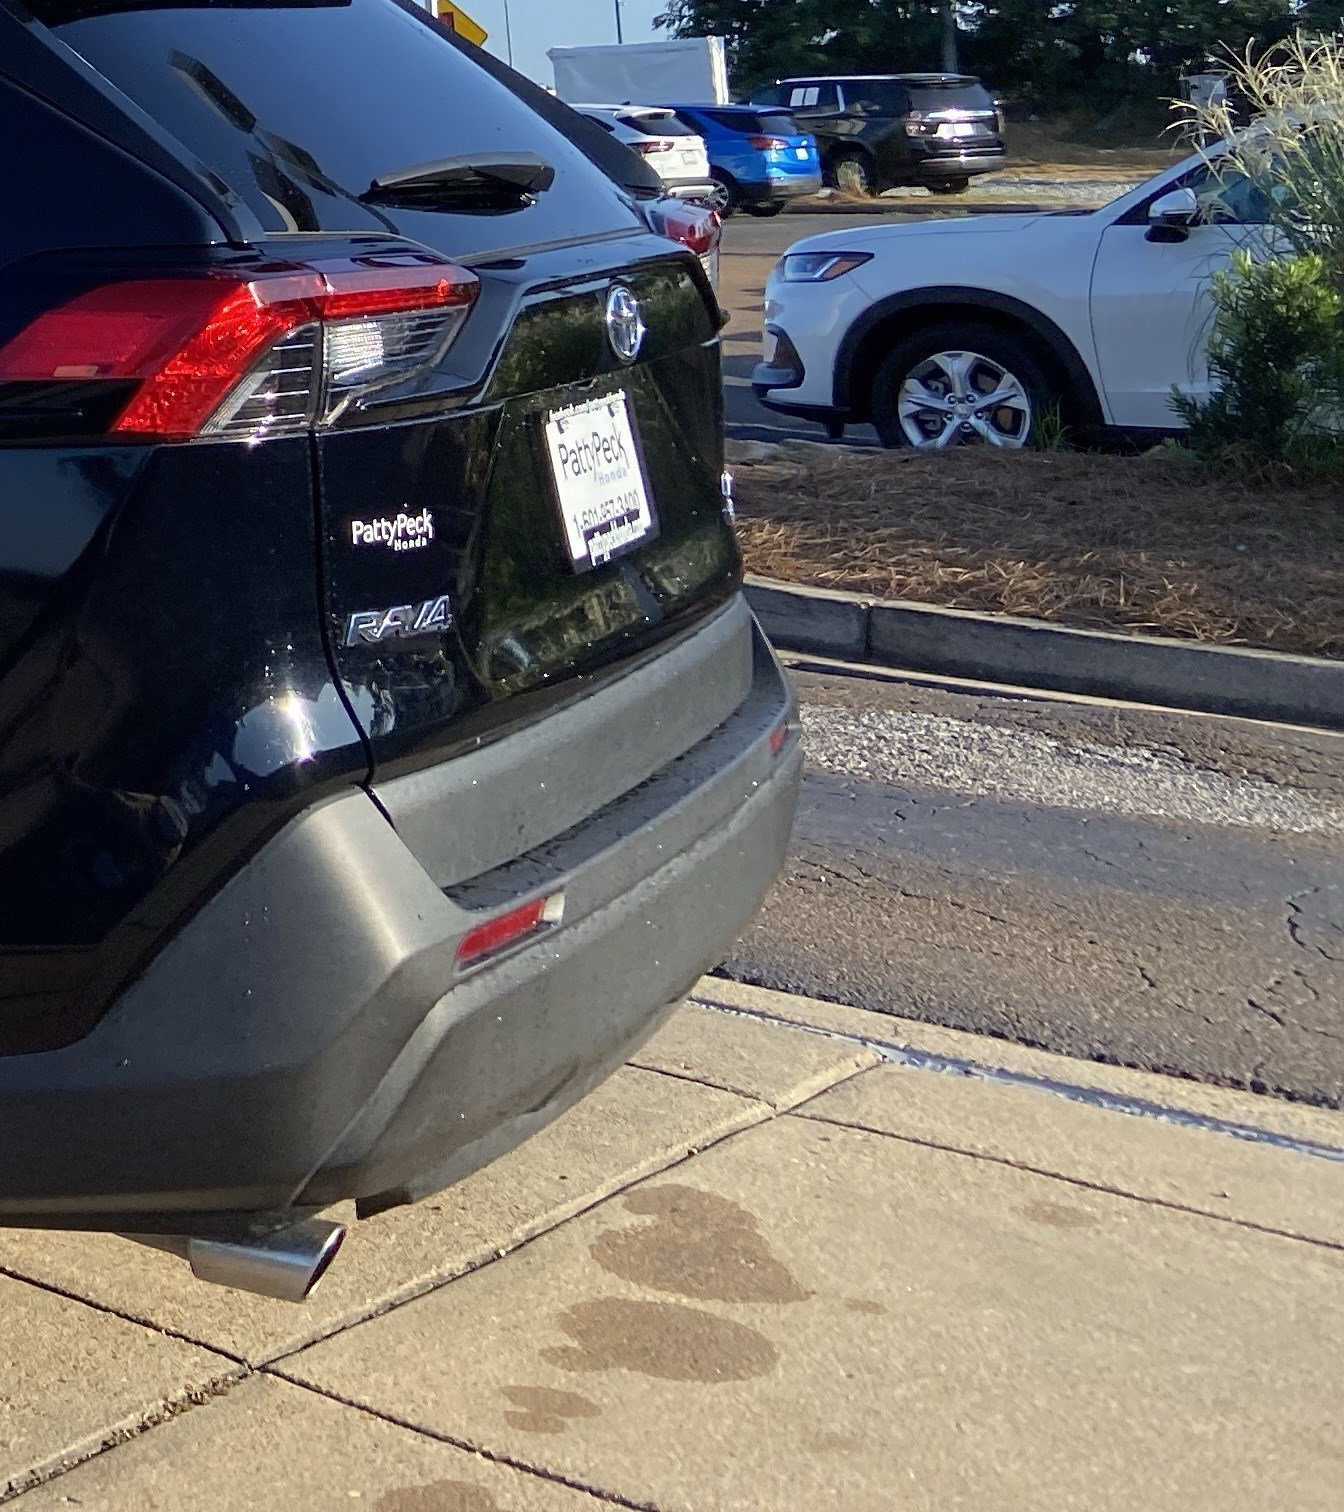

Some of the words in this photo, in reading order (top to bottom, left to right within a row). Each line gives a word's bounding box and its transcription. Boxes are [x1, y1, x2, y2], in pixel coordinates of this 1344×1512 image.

[598, 466, 628, 486] Honda
[394, 535, 427, 551] Honda
[343, 594, 453, 647] RAV4
